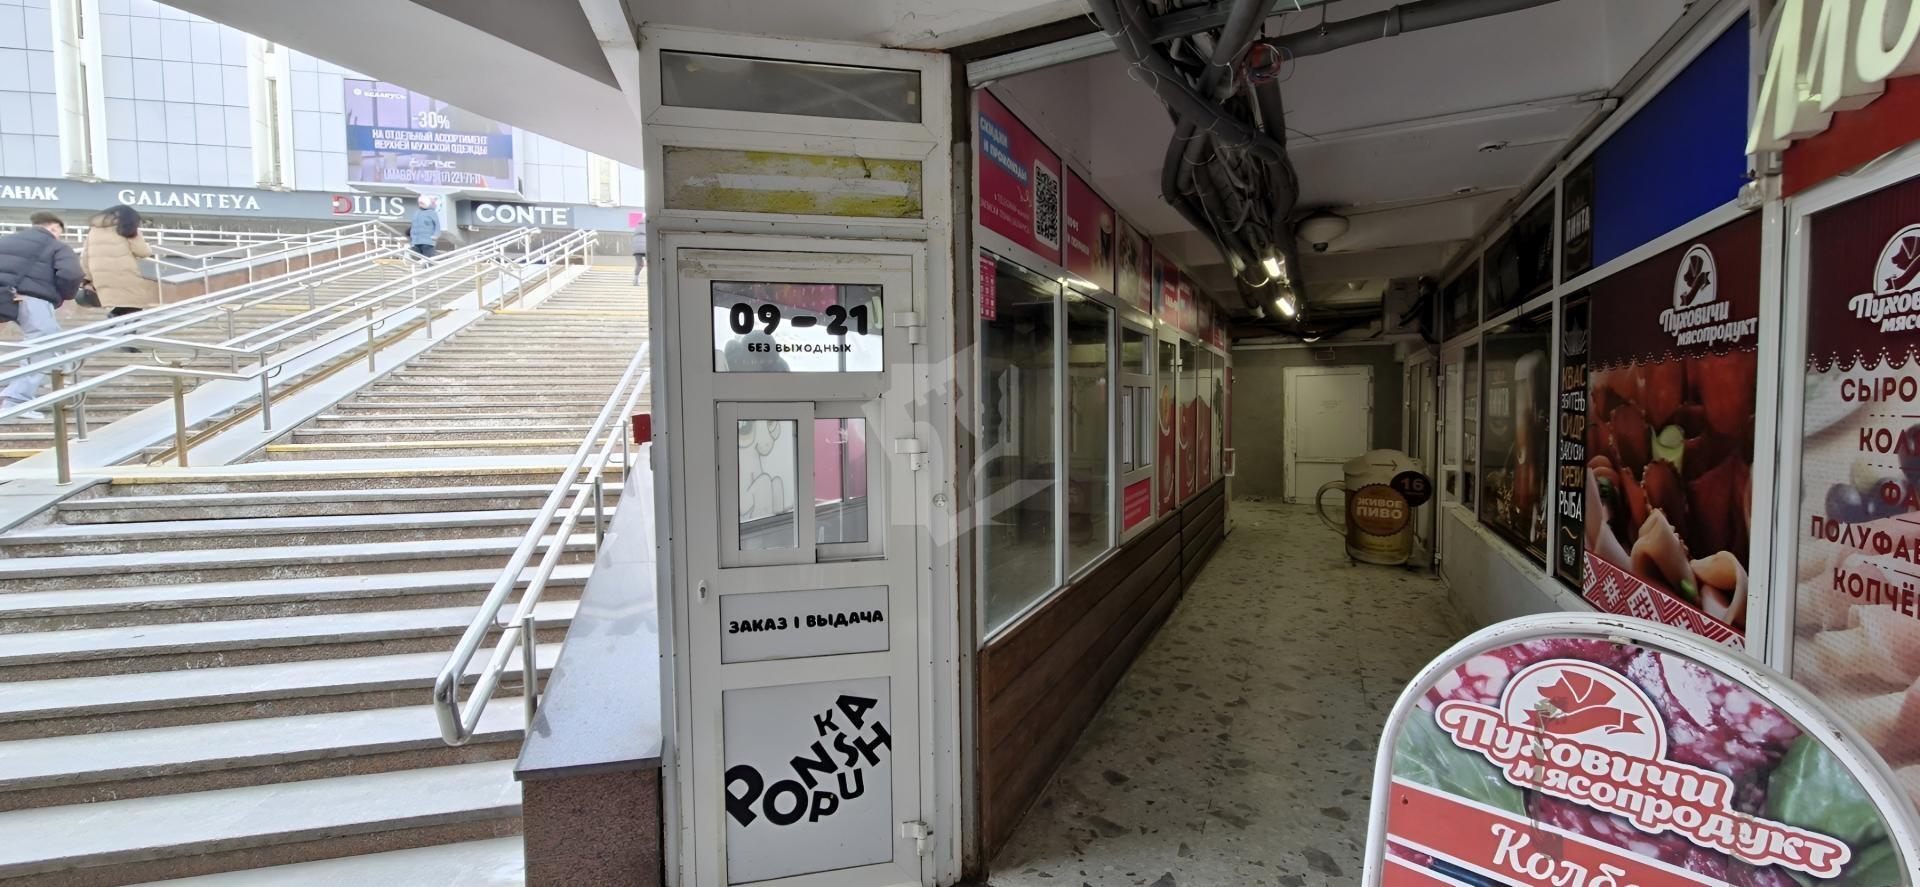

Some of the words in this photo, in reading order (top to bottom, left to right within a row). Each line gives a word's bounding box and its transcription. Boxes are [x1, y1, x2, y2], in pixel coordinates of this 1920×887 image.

[412, 111, 450, 129] -30%
[372, 129, 385, 139] НА
[386, 130, 433, 142] ОТДЕЛЬНЫЙ
[434, 132, 488, 145] АССОРТИМЕНТ
[374, 139, 410, 150] ВЕРХНЕЙ
[411, 141, 450, 152] МУЖСКОЙ
[0, 185, 59, 201] АНАК
[118, 189, 261, 210] GALANTEYA
[332, 195, 405, 216] DILIS
[475, 203, 569, 225] CONTE
[729, 302, 781, 335] 09
[825, 304, 868, 336] 21
[747, 343, 771, 353] БЕЗ
[775, 343, 851, 353] ВЫХОДНЫХ
[1562, 363, 1587, 391] КВАС
[1561, 391, 1586, 412] ЗБИТЕНЬ
[1560, 465, 1584, 488] ОРЕХИ
[1356, 506, 1403, 519] ПИВО
[1357, 497, 1403, 508] ЖИВОЕ
[1559, 490, 1583, 522] РЫБА
[1833, 566, 1920, 620] КОПЧЁ
[728, 617, 788, 634] ЗАКАЗ
[806, 610, 884, 628] ВЫДАЧА
[1445, 708, 1721, 808] Пуховичи
[1513, 760, 1836, 867] мясопродукт
[1491, 823, 1640, 887] Колб
